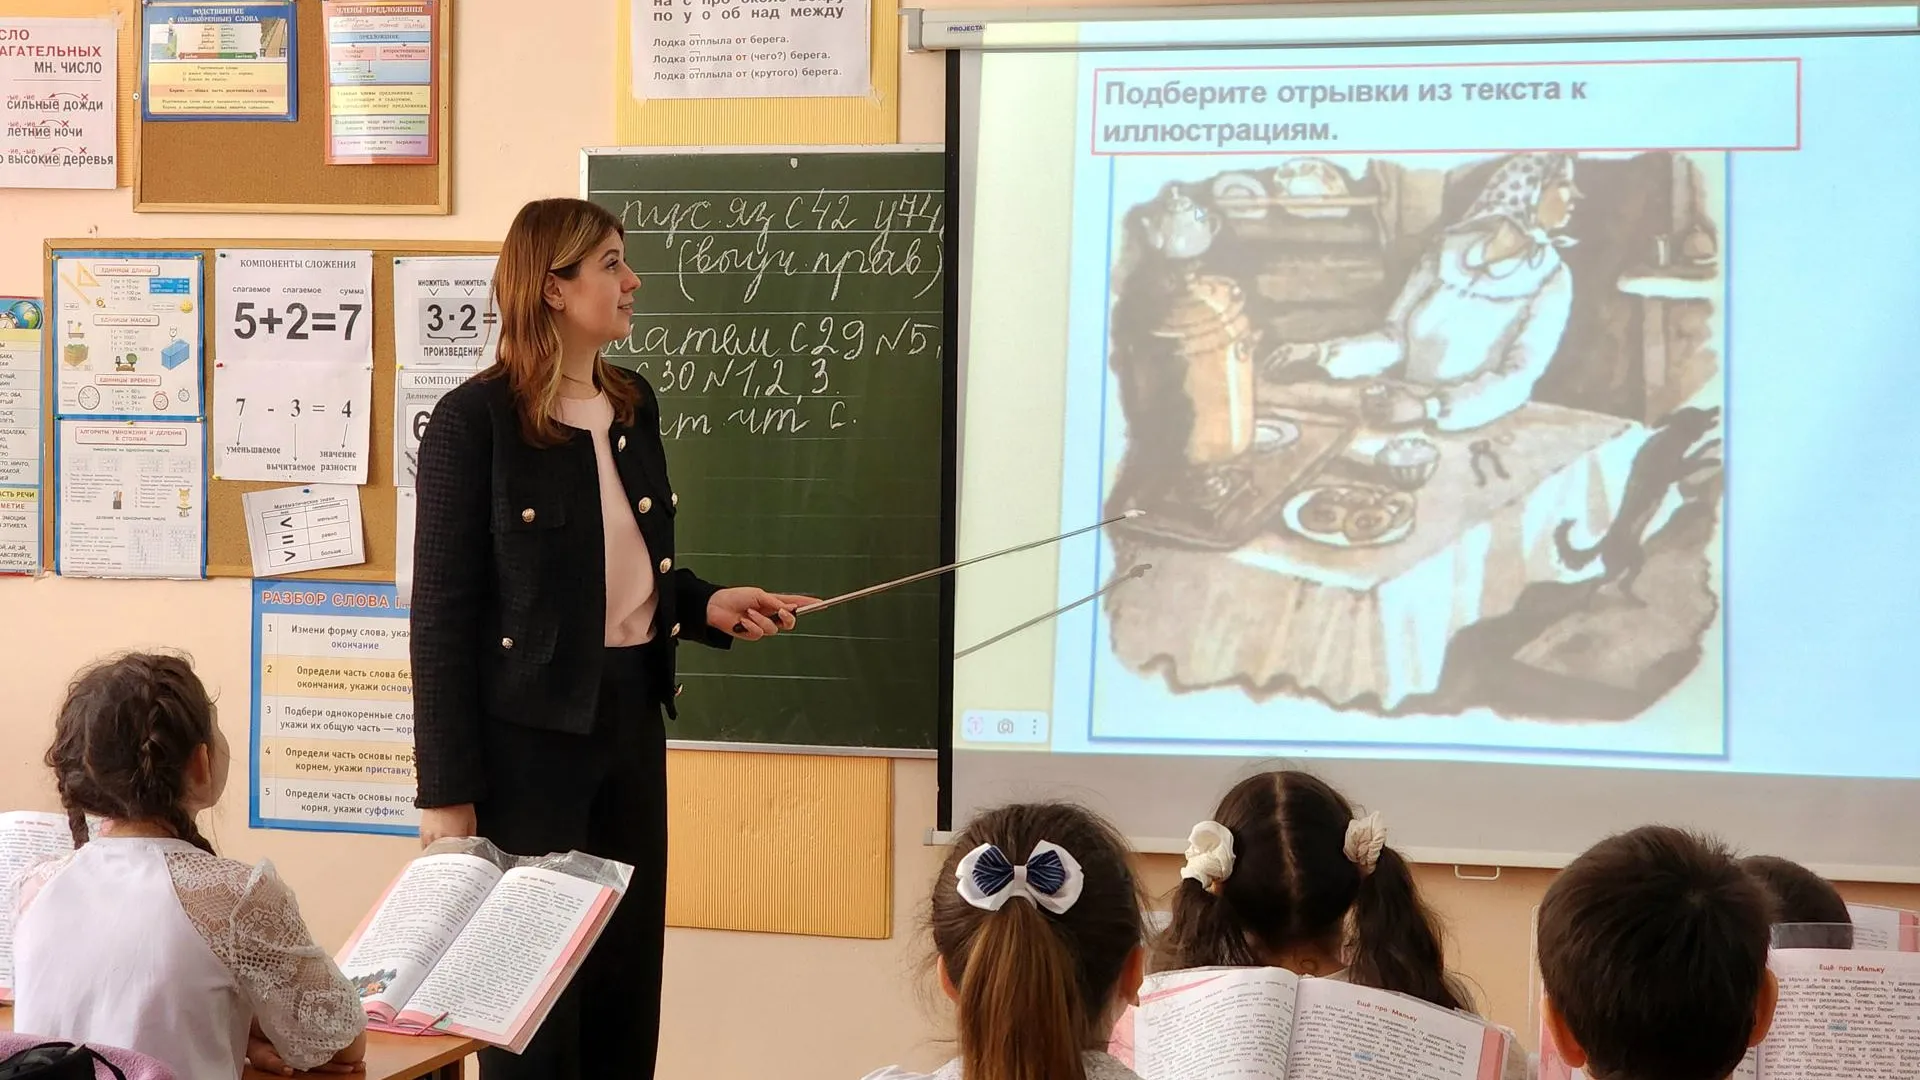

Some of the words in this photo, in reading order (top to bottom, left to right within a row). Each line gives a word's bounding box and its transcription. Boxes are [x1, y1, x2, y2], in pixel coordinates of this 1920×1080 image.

[654, 12, 672, 21] по
[684, 12, 692, 24] у
[702, 10, 711, 20] о
[722, 6, 740, 20] об
[752, 8, 780, 20] над
[790, 6, 844, 19] между
[0, 29, 30, 41] СЛО
[652, 38, 686, 48] Лодка
[690, 36, 732, 46] отплыла
[736, 37, 746, 45] от
[750, 34, 789, 45] берега.
[0, 46, 102, 57] АГАТЕЛЬНЫХ
[652, 54, 686, 64] Лодка
[690, 54, 732, 62] отплыла
[736, 54, 746, 62] от
[750, 52, 787, 62] (чего?)
[790, 50, 830, 60] берега.
[34, 62, 56, 74] МН.
[62, 62, 102, 74] ЧИСЛО
[653, 72, 686, 81] Лодка
[689, 70, 732, 80] отплыла
[736, 70, 746, 78] от
[750, 68, 798, 79] (крутого)
[802, 68, 842, 78] берега.
[1105, 80, 1267, 110] Подберите
[1277, 84, 1408, 109] отрывки
[1418, 84, 1453, 102] из
[1462, 81, 1561, 101] текста
[1570, 81, 1588, 100] к
[7, 100, 59, 110] сильные
[63, 100, 103, 111] дожди
[7, 127, 50, 136] летние
[54, 127, 83, 137] ночи
[1103, 122, 1338, 148] иллюстрациям.
[8, 154, 59, 164] высокие
[63, 154, 114, 167] деревья
[240, 259, 302, 269] КОМПОНЕНТЫ
[305, 260, 356, 270] СЛОЖЕНИЯ
[232, 286, 270, 294] слагаемое
[282, 286, 322, 294] слагаемое
[340, 288, 364, 296] сумма
[234, 302, 362, 341] 5+2=7
[427, 304, 444, 332] 3
[460, 304, 476, 331] 2
[424, 347, 483, 358] ПРОИЗВЕДЕНИЕ
[414, 376, 471, 384] КОМПОНЕ
[236, 398, 246, 416] 7
[290, 399, 300, 418] 3
[342, 400, 352, 418] 4
[413, 410, 432, 442] 6
[226, 446, 281, 455] уменьшаемое
[320, 450, 356, 458] значение
[266, 463, 316, 472] вычитаемое
[320, 464, 357, 472] разности
[262, 590, 326, 606] РАЗБОР
[333, 593, 390, 608] СЛОВА
[268, 624, 272, 632] 1
[292, 625, 325, 634] Измени
[328, 625, 358, 638] форму
[360, 628, 388, 638] слова,
[331, 641, 379, 650] окончание
[267, 665, 272, 673] 2
[296, 666, 341, 677] Определи
[344, 669, 366, 677] часть
[370, 670, 395, 678] слова
[297, 682, 347, 691] окончания,
[350, 683, 378, 692] укажи
[380, 684, 412, 694] основу
[266, 706, 272, 714] 3
[284, 706, 323, 717] Подбери
[326, 710, 392, 720] однокоренные
[280, 720, 308, 731] укажи
[310, 722, 320, 730] их
[323, 720, 354, 732] общую
[357, 724, 381, 732] часть
[396, 726, 414, 735] кор
[266, 747, 271, 756] 4
[285, 748, 330, 758] Определи
[332, 751, 356, 760] часть
[358, 752, 392, 760] основы
[296, 764, 331, 773] корнем,
[334, 765, 362, 774] укажи
[366, 766, 412, 776] приставку
[266, 788, 270, 796] 5
[285, 788, 330, 799] Определи
[332, 792, 356, 800] часть
[358, 794, 392, 802] основы
[394, 795, 416, 803] посл
[301, 804, 330, 813] корня,
[334, 806, 362, 814] укажи
[364, 805, 404, 816] суффикс
[1857, 966, 1885, 974] Мальку
[1374, 1004, 1388, 1012] про
